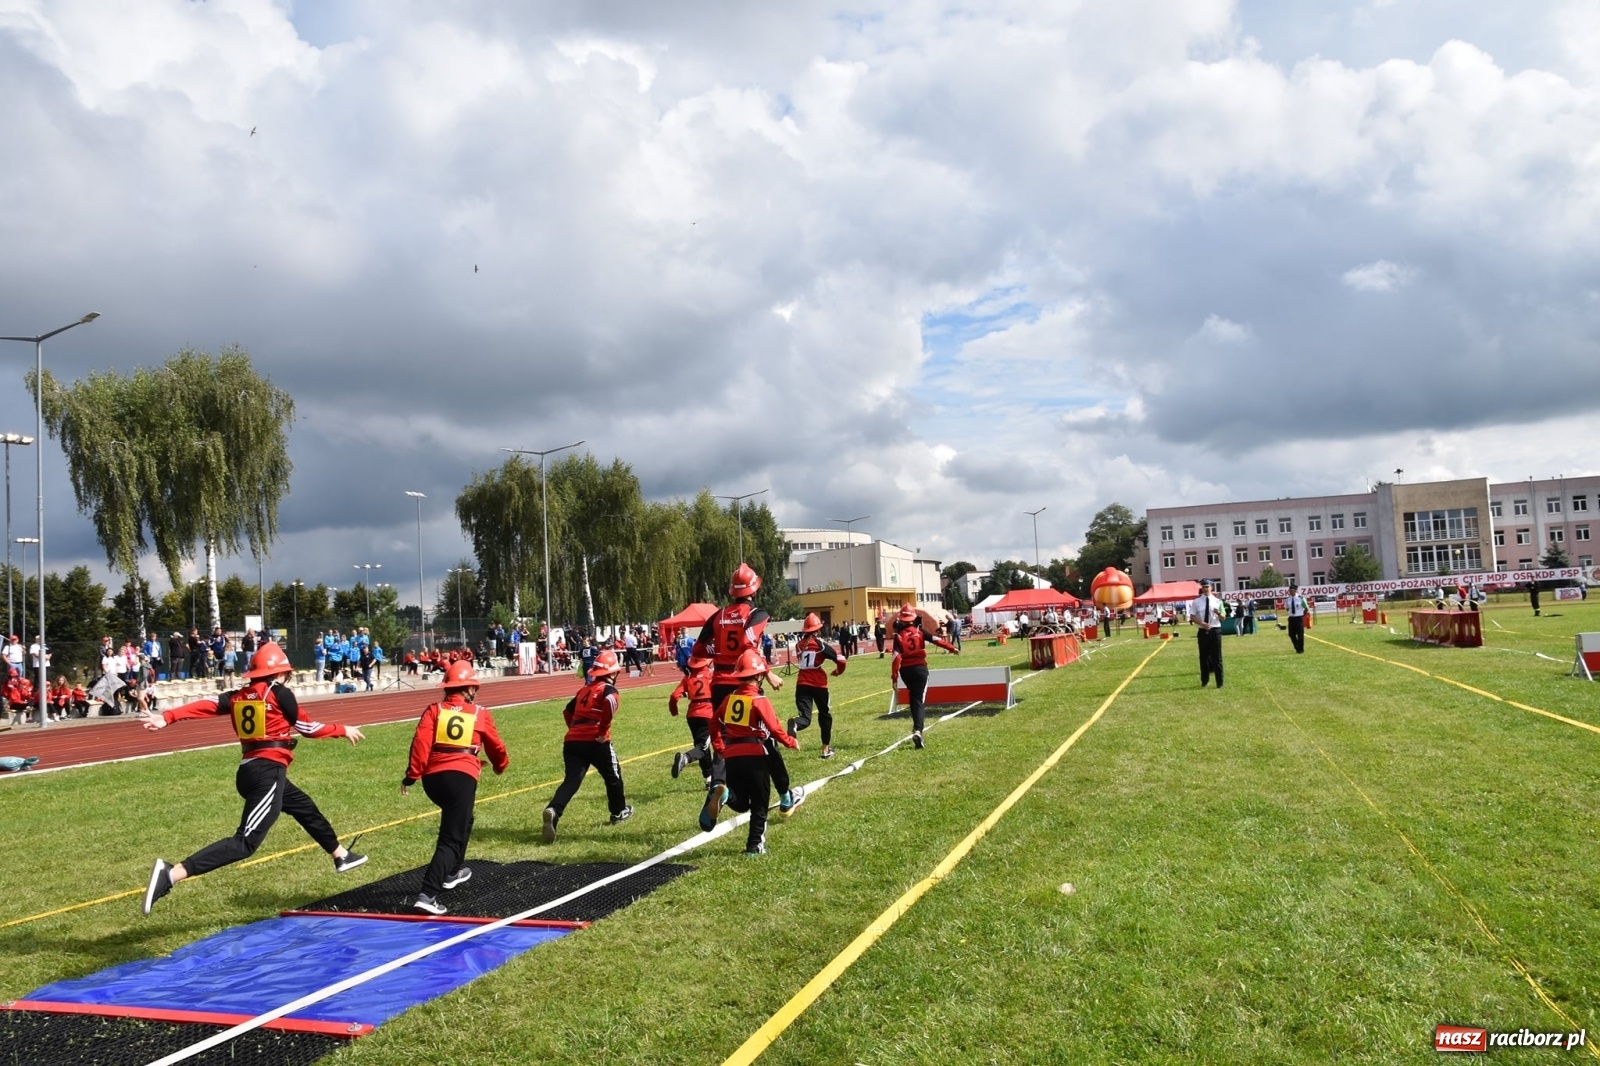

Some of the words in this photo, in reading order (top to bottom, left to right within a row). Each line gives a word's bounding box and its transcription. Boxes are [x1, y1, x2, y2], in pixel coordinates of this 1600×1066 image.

[1301, 586, 1340, 596] ZAWODY
[1345, 577, 1458, 592] SPORTOWO-POŻARNICZE
[1463, 574, 1483, 584] CTIF
[1487, 573, 1508, 582] MDP
[1513, 572, 1533, 581] OSP
[1535, 570, 1555, 579] KDP
[1560, 569, 1580, 578] PSP
[726, 630, 739, 652] 5
[907, 637, 916, 651] 3
[804, 653, 811, 667] 1
[580, 689, 592, 708] 4
[693, 680, 705, 697] 2
[241, 704, 256, 735] 8
[731, 699, 745, 723] 9
[446, 715, 465, 741] 6
